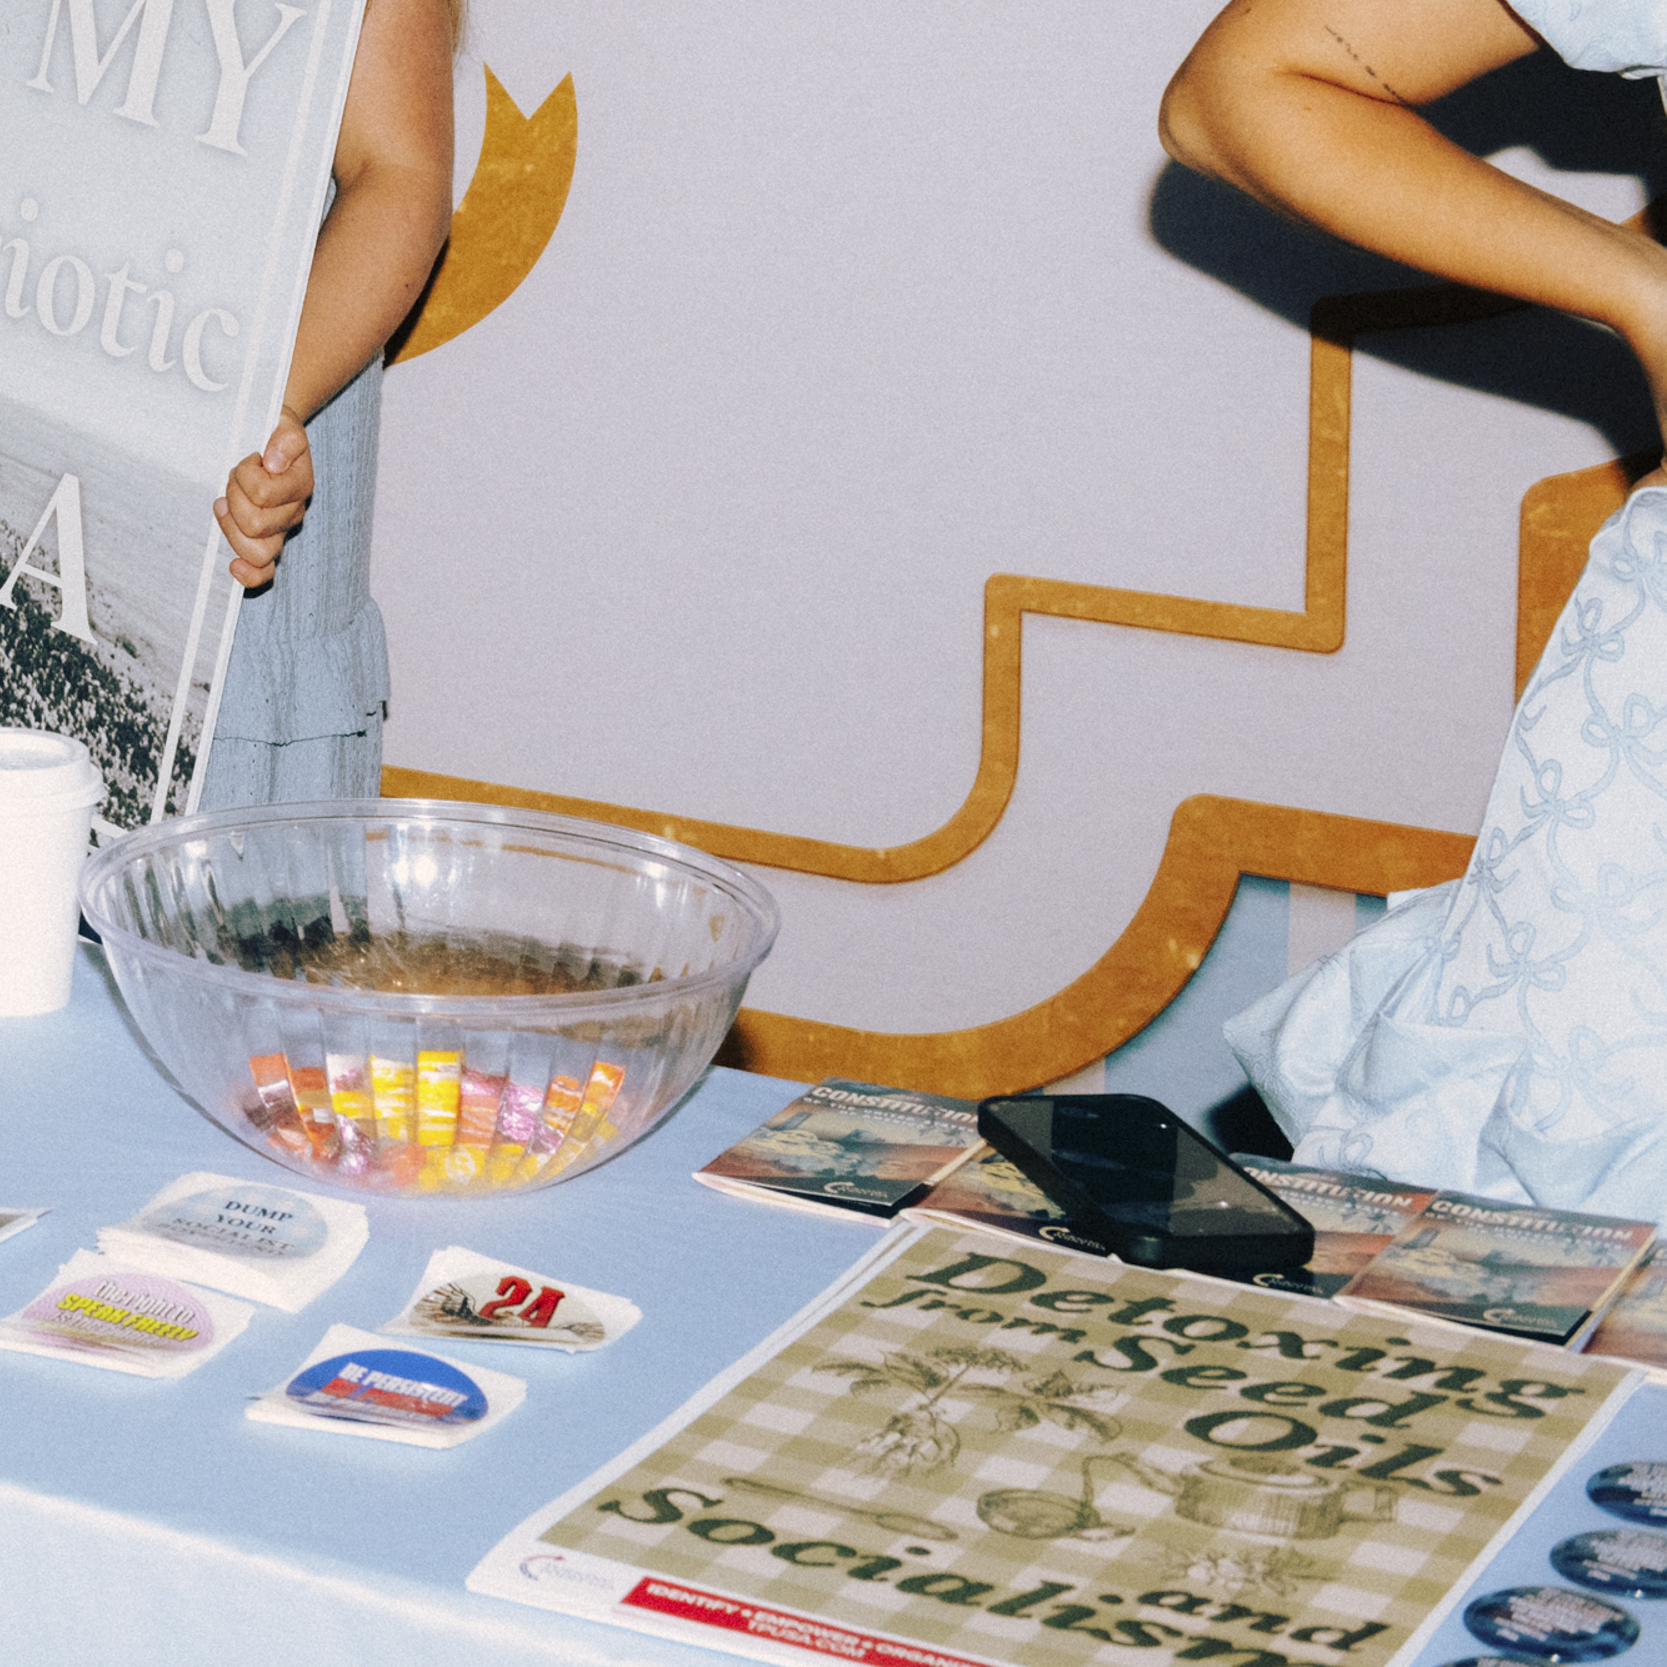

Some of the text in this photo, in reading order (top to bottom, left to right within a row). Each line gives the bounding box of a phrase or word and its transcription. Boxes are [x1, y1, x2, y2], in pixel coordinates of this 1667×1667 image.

[216, 1214, 277, 1235] YOUR
[224, 1200, 294, 1222] DUMP
[56, 1292, 132, 1324] SPEAK
[93, 1279, 196, 1324] the right to
[479, 1274, 566, 1328] 24
[860, 1288, 1089, 1345] from
[906, 1251, 1587, 1420] Detoxing
[337, 1361, 369, 1383] BE
[361, 1369, 469, 1408] PERSISTENT
[1071, 1332, 1448, 1429] Seed
[1183, 1409, 1504, 1497] Oils
[646, 1582, 741, 1615] IDENTIFY
[1136, 1589, 1392, 1652] and
